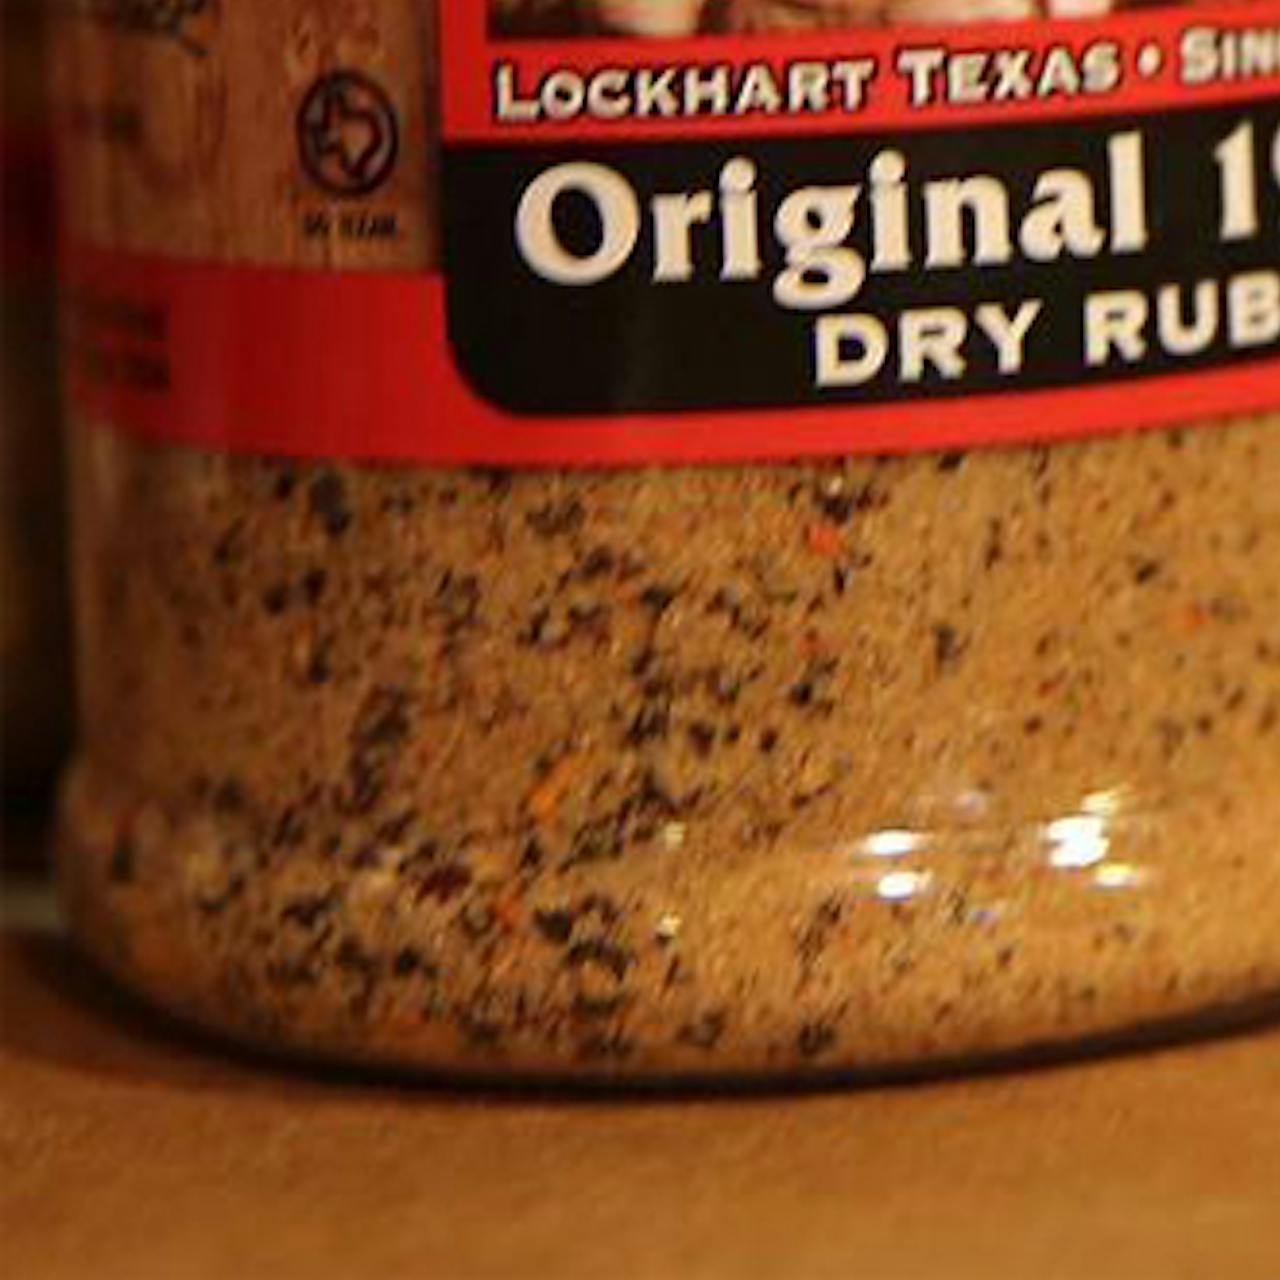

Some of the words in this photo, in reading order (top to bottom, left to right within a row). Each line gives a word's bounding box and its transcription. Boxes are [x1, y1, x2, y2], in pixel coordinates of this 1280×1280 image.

[494, 56, 874, 121] LOCKHART
[898, 42, 1119, 107] TEXAS
[516, 132, 1146, 308] Original
[814, 300, 1043, 388] DRY
